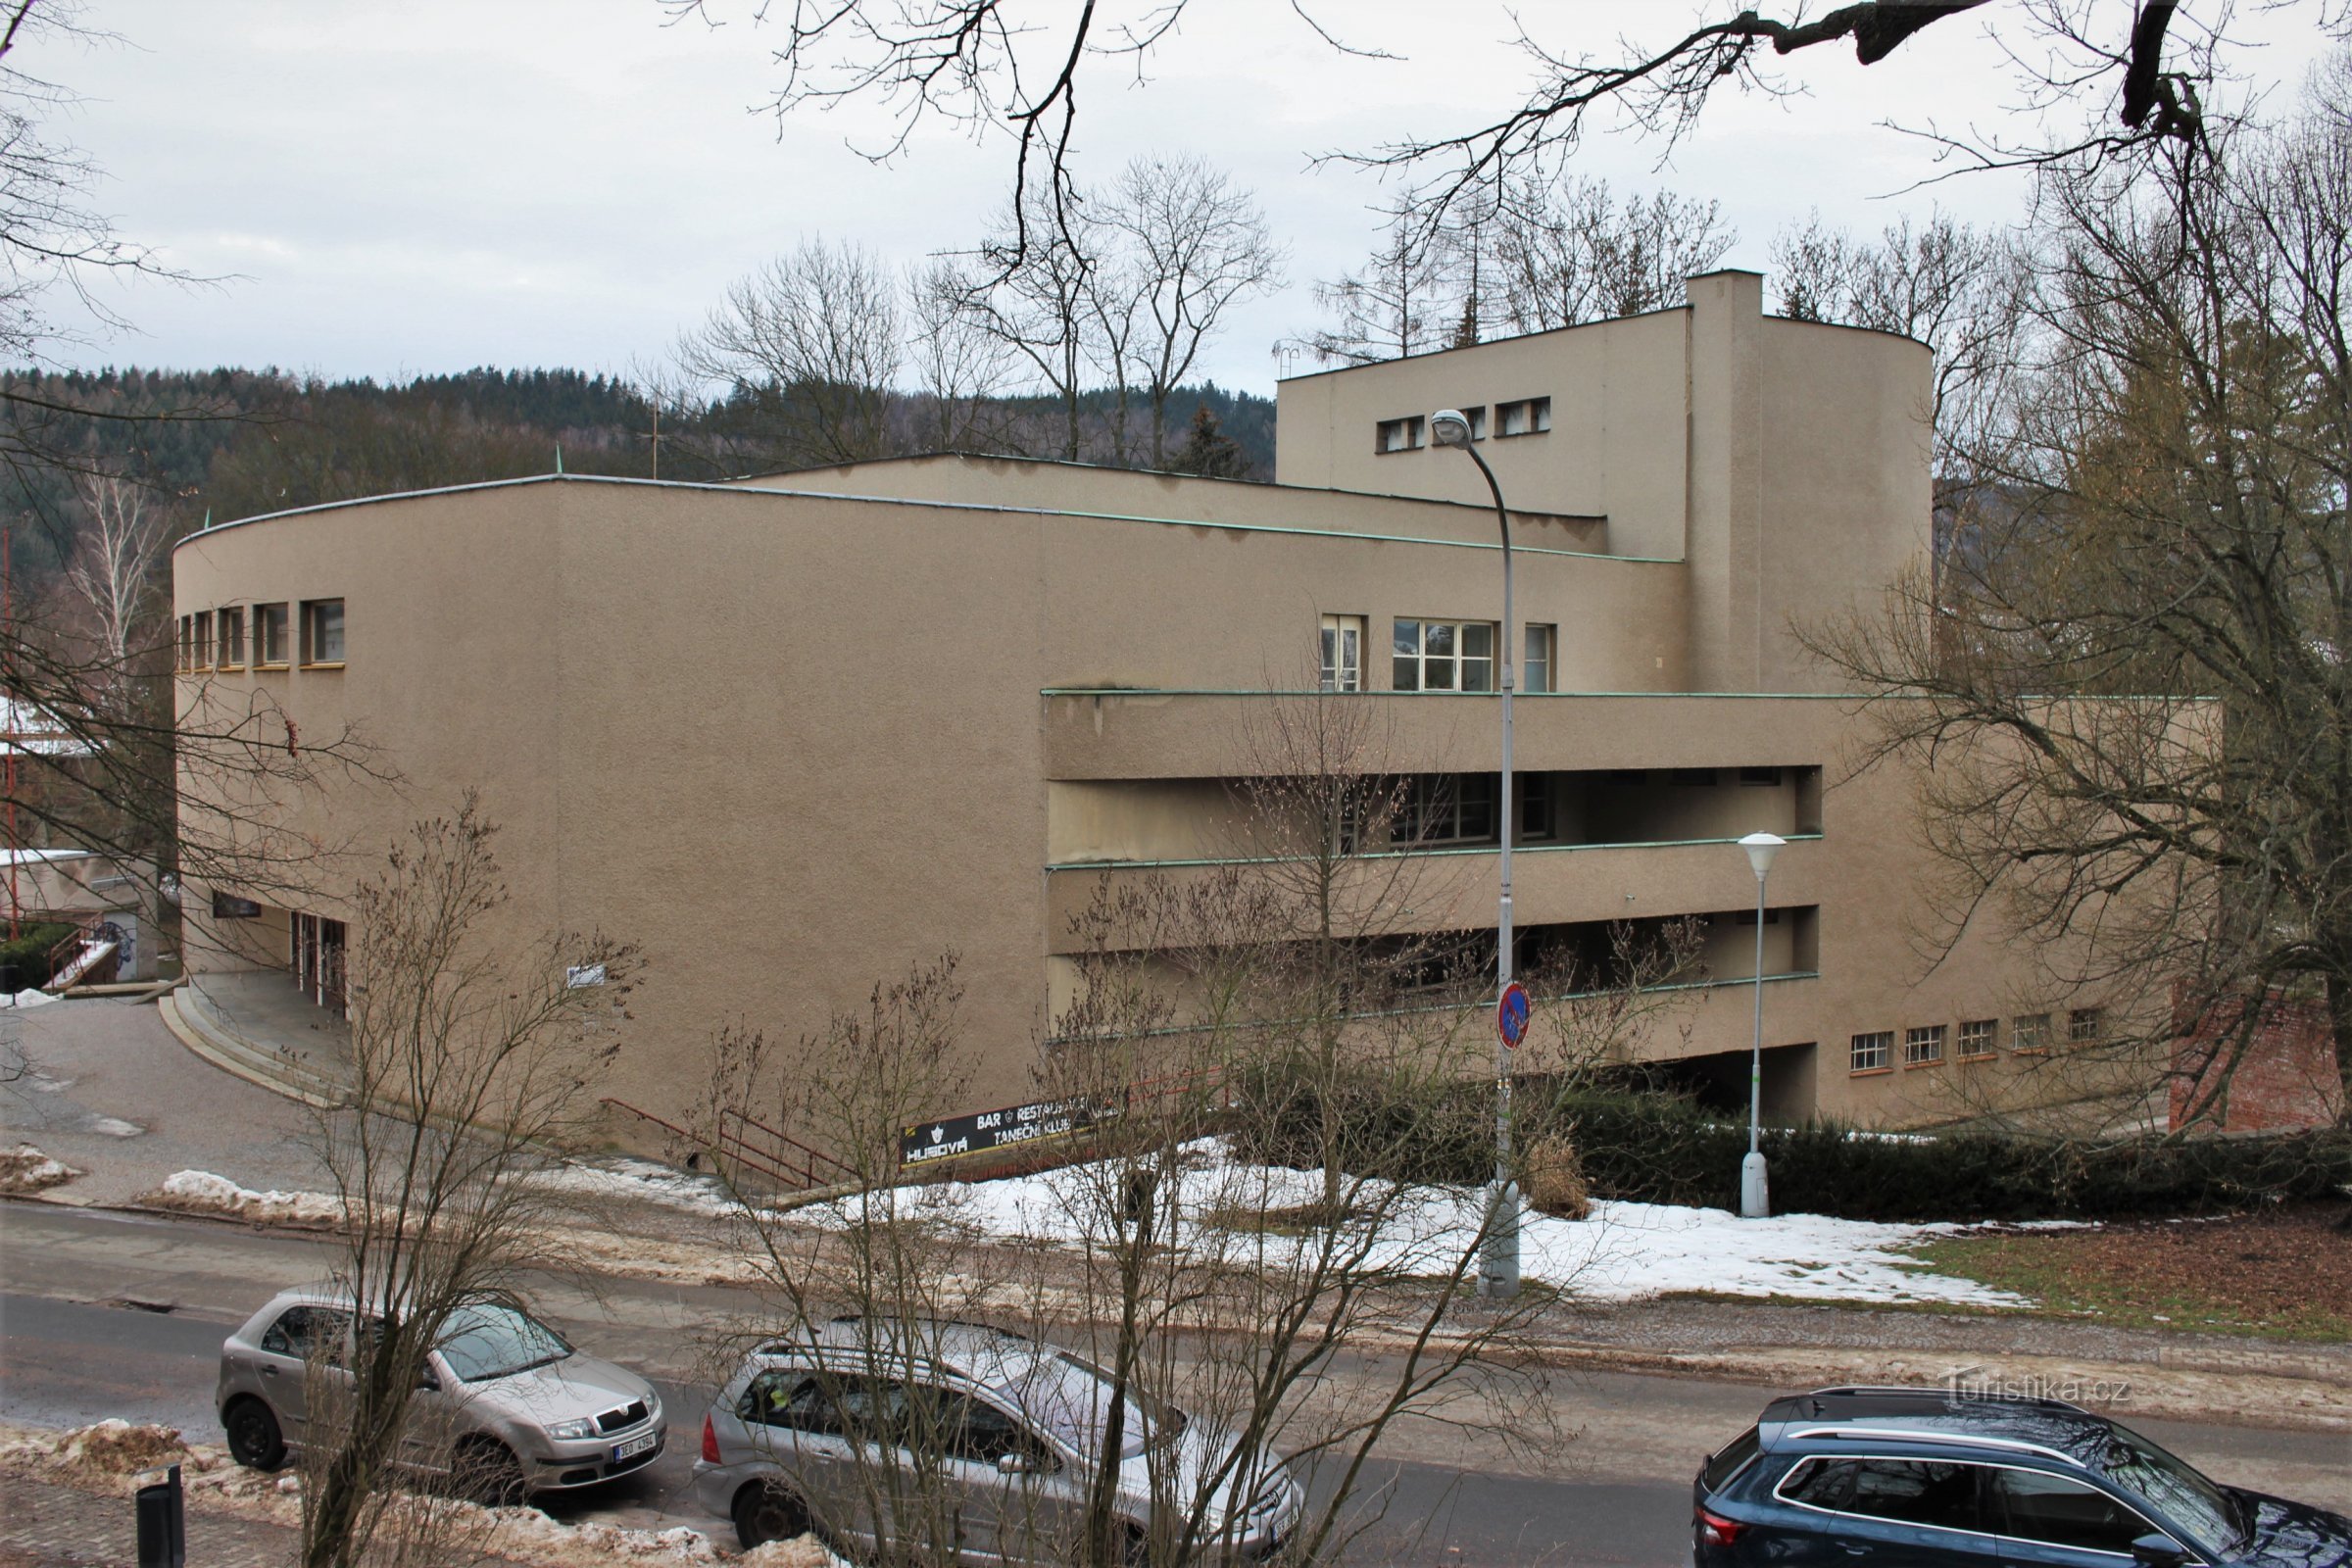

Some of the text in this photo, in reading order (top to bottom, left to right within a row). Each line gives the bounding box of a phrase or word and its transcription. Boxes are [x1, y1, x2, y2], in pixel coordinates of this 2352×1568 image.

[977, 1113, 1001, 1130] BAR
[994, 1120, 1043, 1146] TANEČNÍ
[906, 1136, 968, 1163] HUSOVÁ
